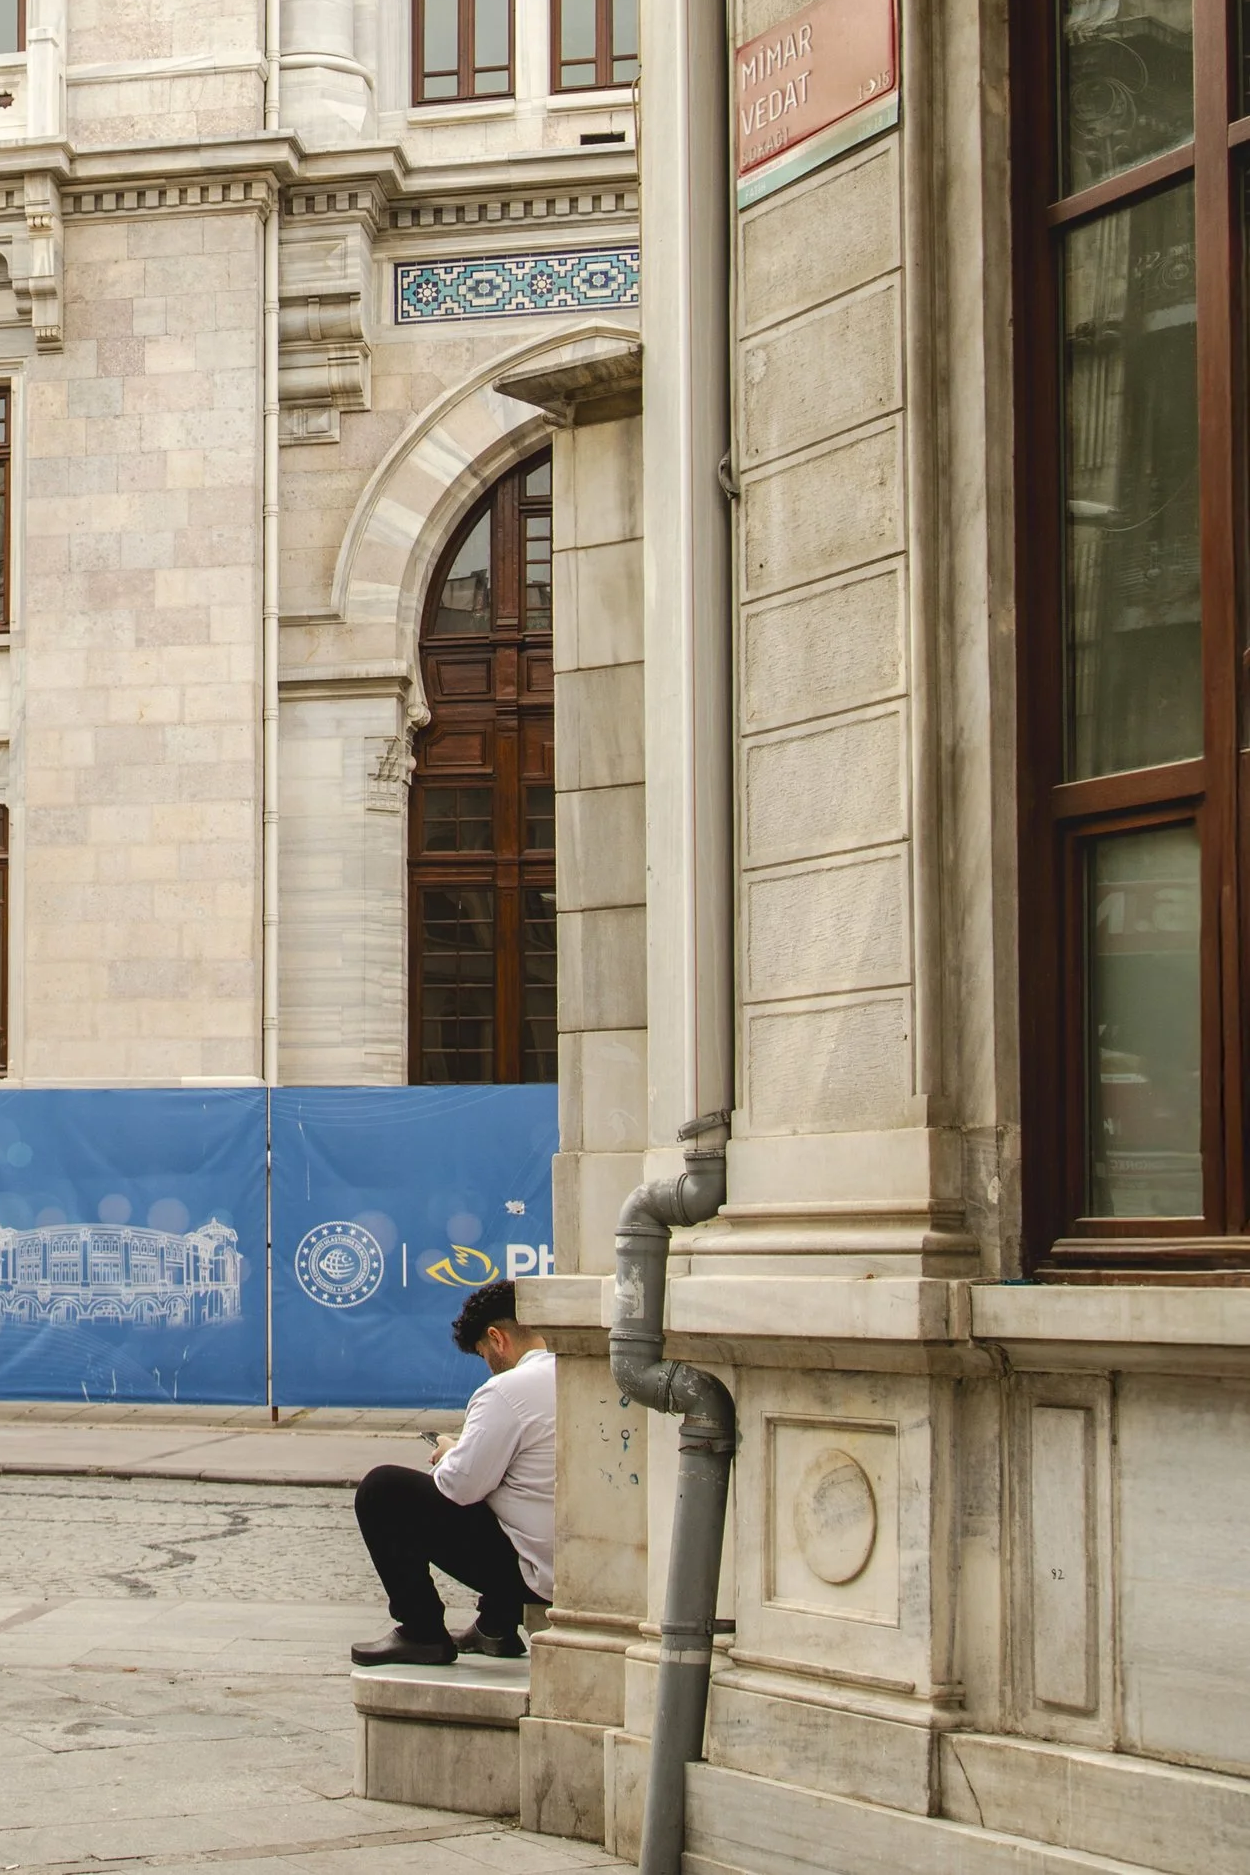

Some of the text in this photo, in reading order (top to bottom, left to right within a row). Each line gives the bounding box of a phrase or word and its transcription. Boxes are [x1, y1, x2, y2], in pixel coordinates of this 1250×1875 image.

[742, 24, 813, 92] MİMAR
[740, 70, 812, 136] VEDAT
[741, 127, 789, 166] SOKAĞI
